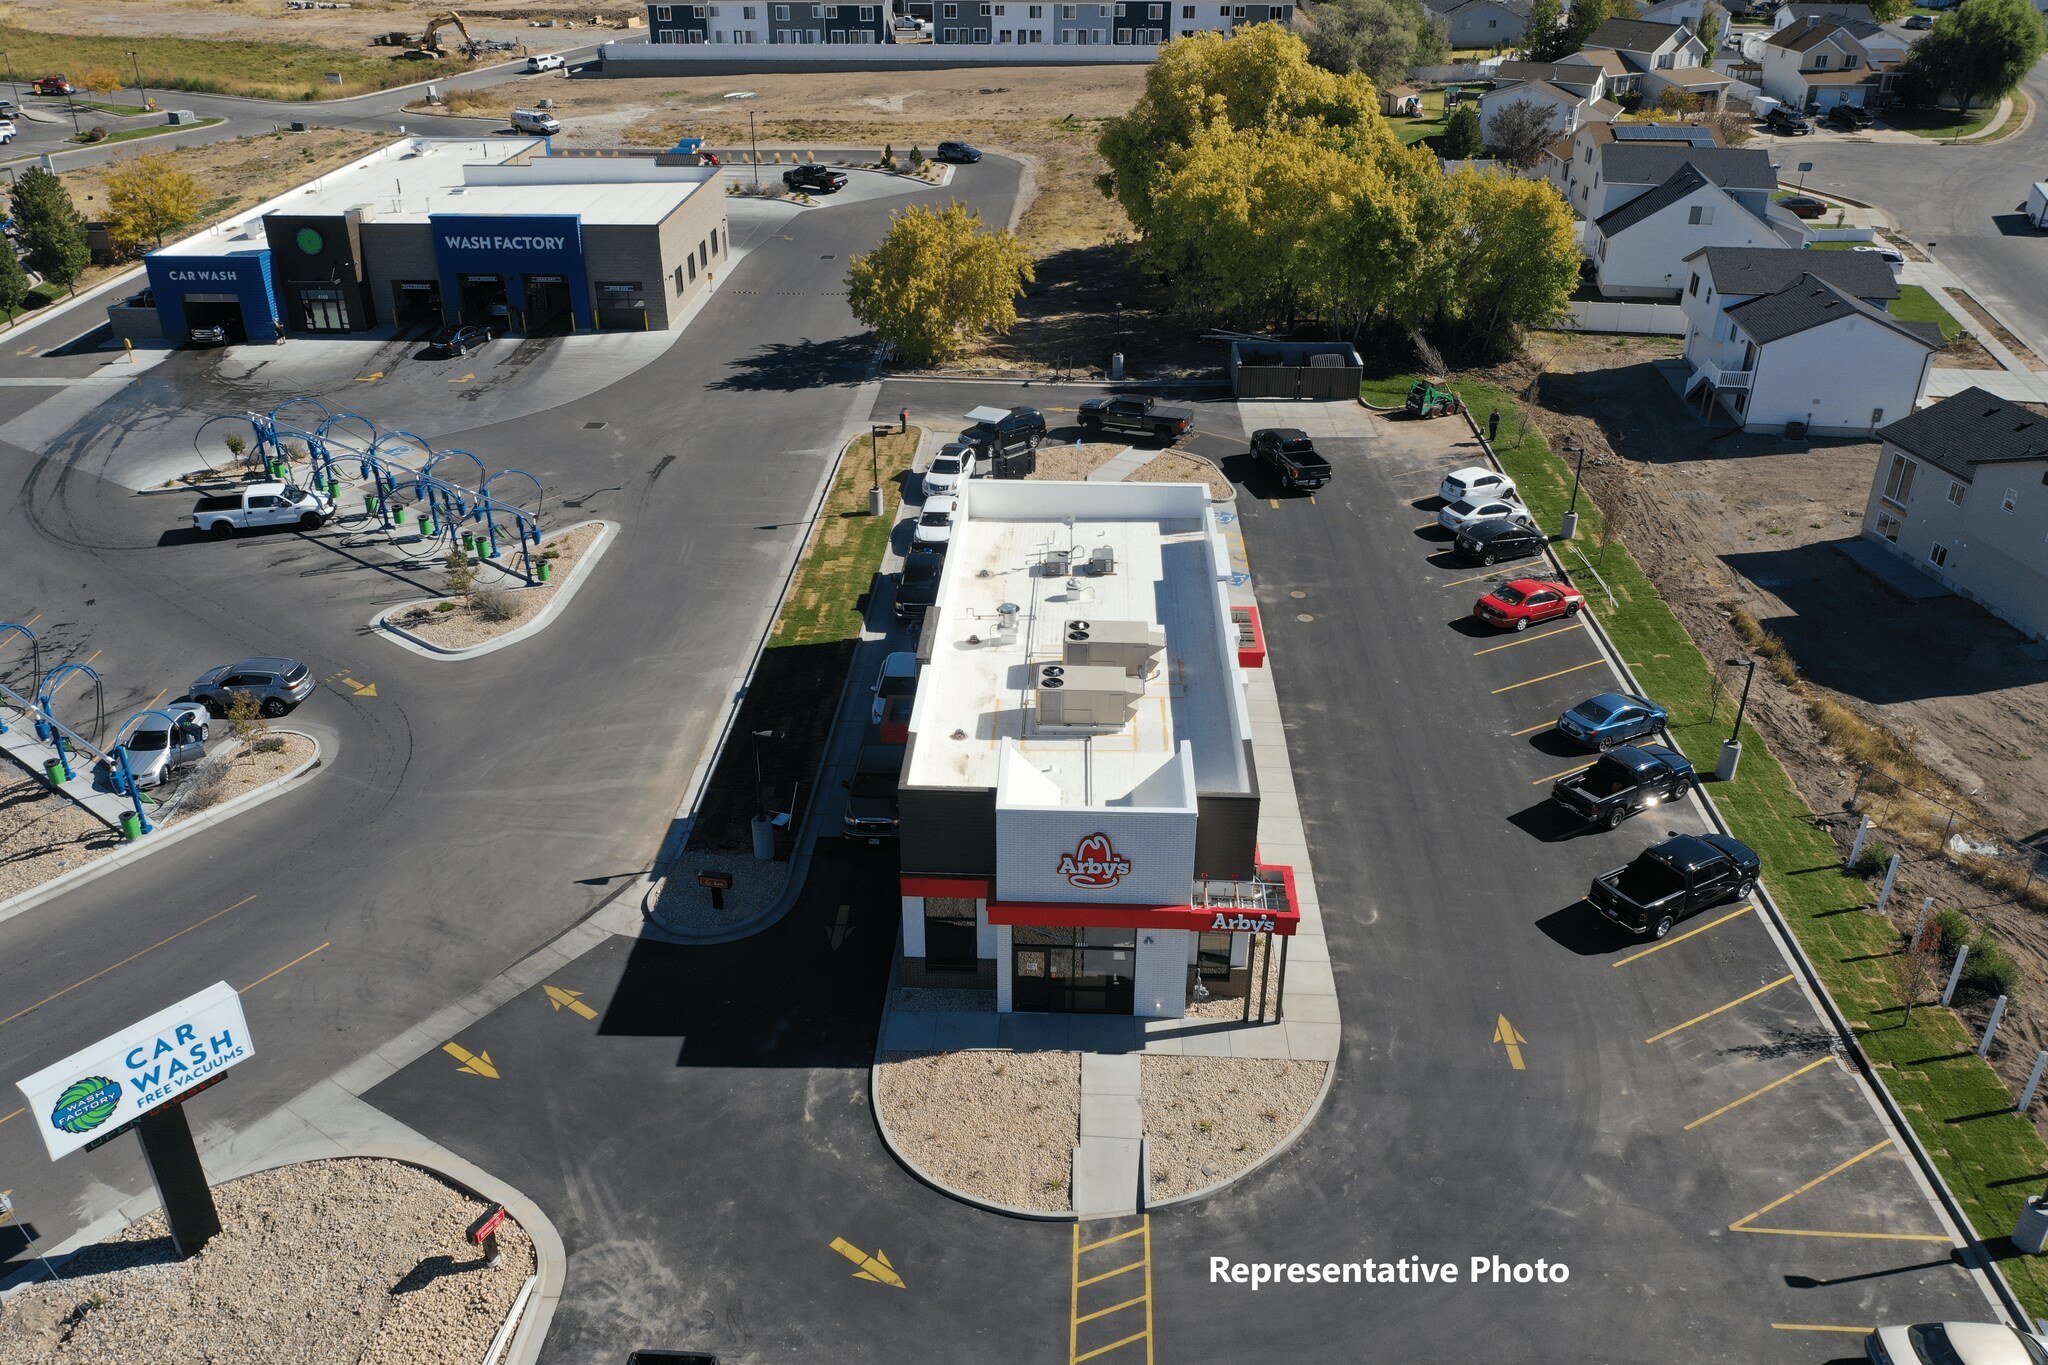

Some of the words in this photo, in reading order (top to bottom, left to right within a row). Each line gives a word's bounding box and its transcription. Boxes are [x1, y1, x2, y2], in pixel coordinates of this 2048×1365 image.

[444, 236, 492, 249] WASH
[493, 236, 565, 250] FACTORY
[168, 270, 196, 281] CAR
[197, 271, 238, 281] WASH
[1058, 857, 1132, 879] Arby's
[1211, 913, 1275, 935] Arby's
[125, 1023, 197, 1070] CAR
[130, 1029, 233, 1093] WASH
[136, 1083, 173, 1109] FREE
[174, 1046, 244, 1086] VACUUMS
[58, 1092, 117, 1126] FACTORY
[66, 1089, 105, 1113] WASH
